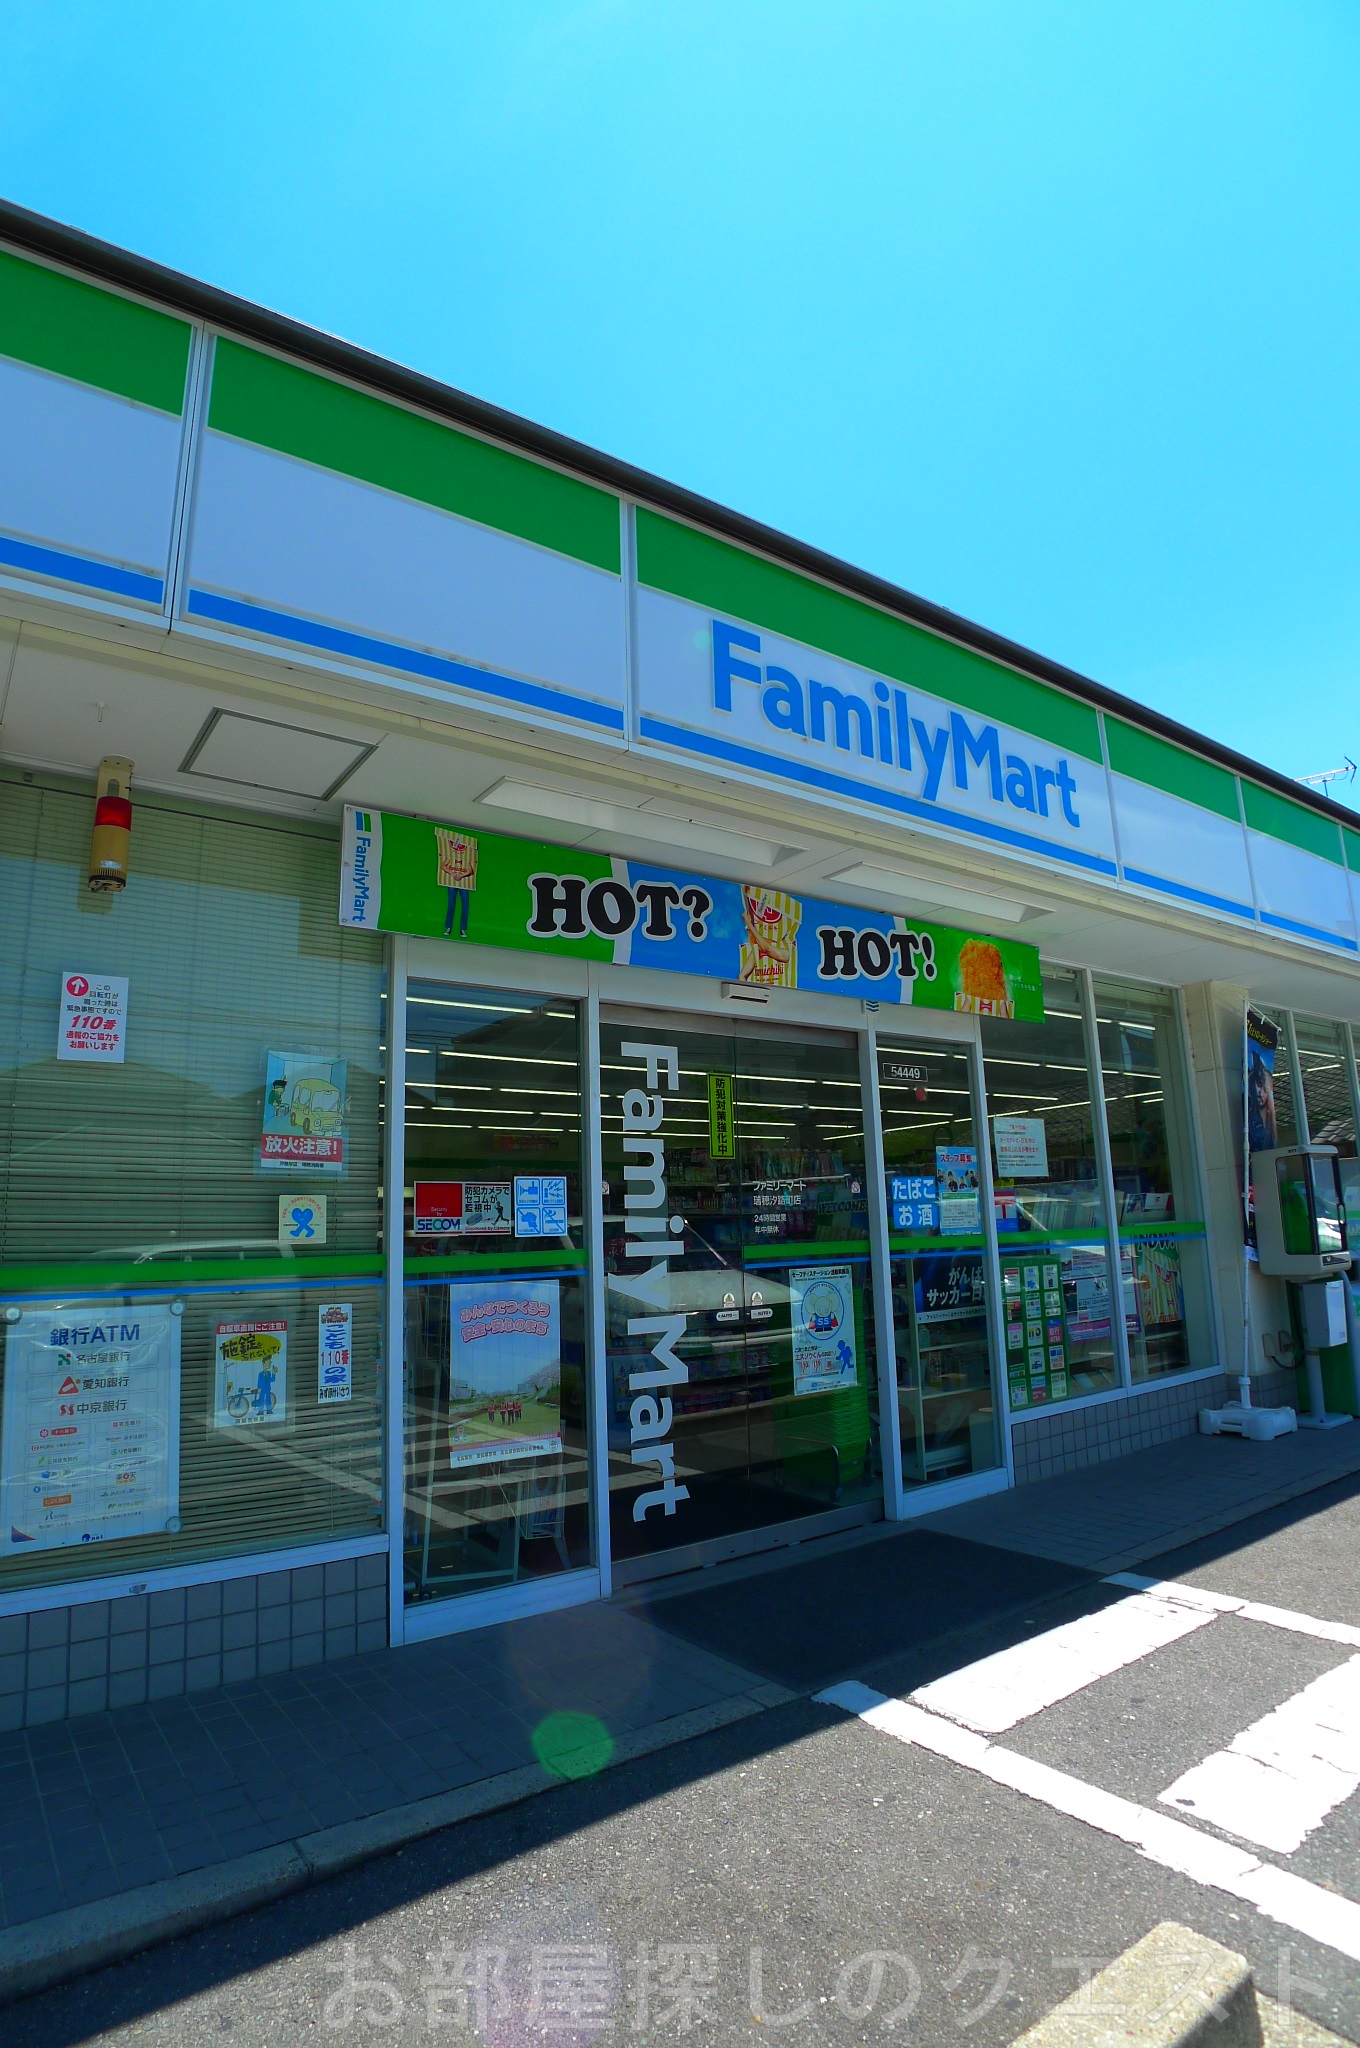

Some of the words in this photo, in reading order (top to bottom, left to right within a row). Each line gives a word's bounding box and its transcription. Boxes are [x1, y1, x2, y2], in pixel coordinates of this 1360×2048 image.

[712, 619, 1080, 828] FamilyMart
[351, 836, 372, 922] FamilyMart
[529, 874, 712, 940] HOT?
[817, 927, 935, 980] HOT!
[96, 983, 110, 991] この
[89, 991, 119, 999] 回転灯が
[84, 998, 118, 1007] 鳴った時は
[66, 1005, 122, 1015] 緊急事態ですので
[71, 1015, 117, 1030] 110番
[66, 1030, 119, 1042] 通報のご協力を
[69, 1041, 116, 1051] お願いします
[890, 1065, 921, 1080] 54449
[715, 1077, 728, 1155] 防犯対策強化中
[264, 1135, 338, 1156] 放火注意!
[940, 1153, 973, 1164] スタッフ募集
[464, 1186, 510, 1196] 防犯カメラで
[752, 1180, 807, 1191] ファミリーマート
[892, 1178, 936, 1201] たばこ
[465, 1195, 498, 1204] セコムが
[464, 1203, 492, 1213] 監視中
[898, 1203, 934, 1227] お酒
[417, 1218, 461, 1231] SECOM
[754, 1213, 787, 1223] 24時間営業
[754, 1226, 780, 1234] 年中無休
[608, 1041, 691, 1522] FamilyMart
[926, 1286, 986, 1307] サッカー日
[459, 1299, 550, 1323] みんなでつくろう
[219, 1321, 285, 1334] 自転車盗難にご注意!
[817, 1317, 830, 1326] SS
[50, 1323, 140, 1346] 銀行ATM
[460, 1317, 549, 1343] 安全・安心のまち
[75, 1351, 131, 1365] 名古屋銀行
[82, 1376, 130, 1391] 愛知銀行
[319, 1386, 350, 1400] みずほけいさつ
[76, 1399, 128, 1415] 中京銀行
